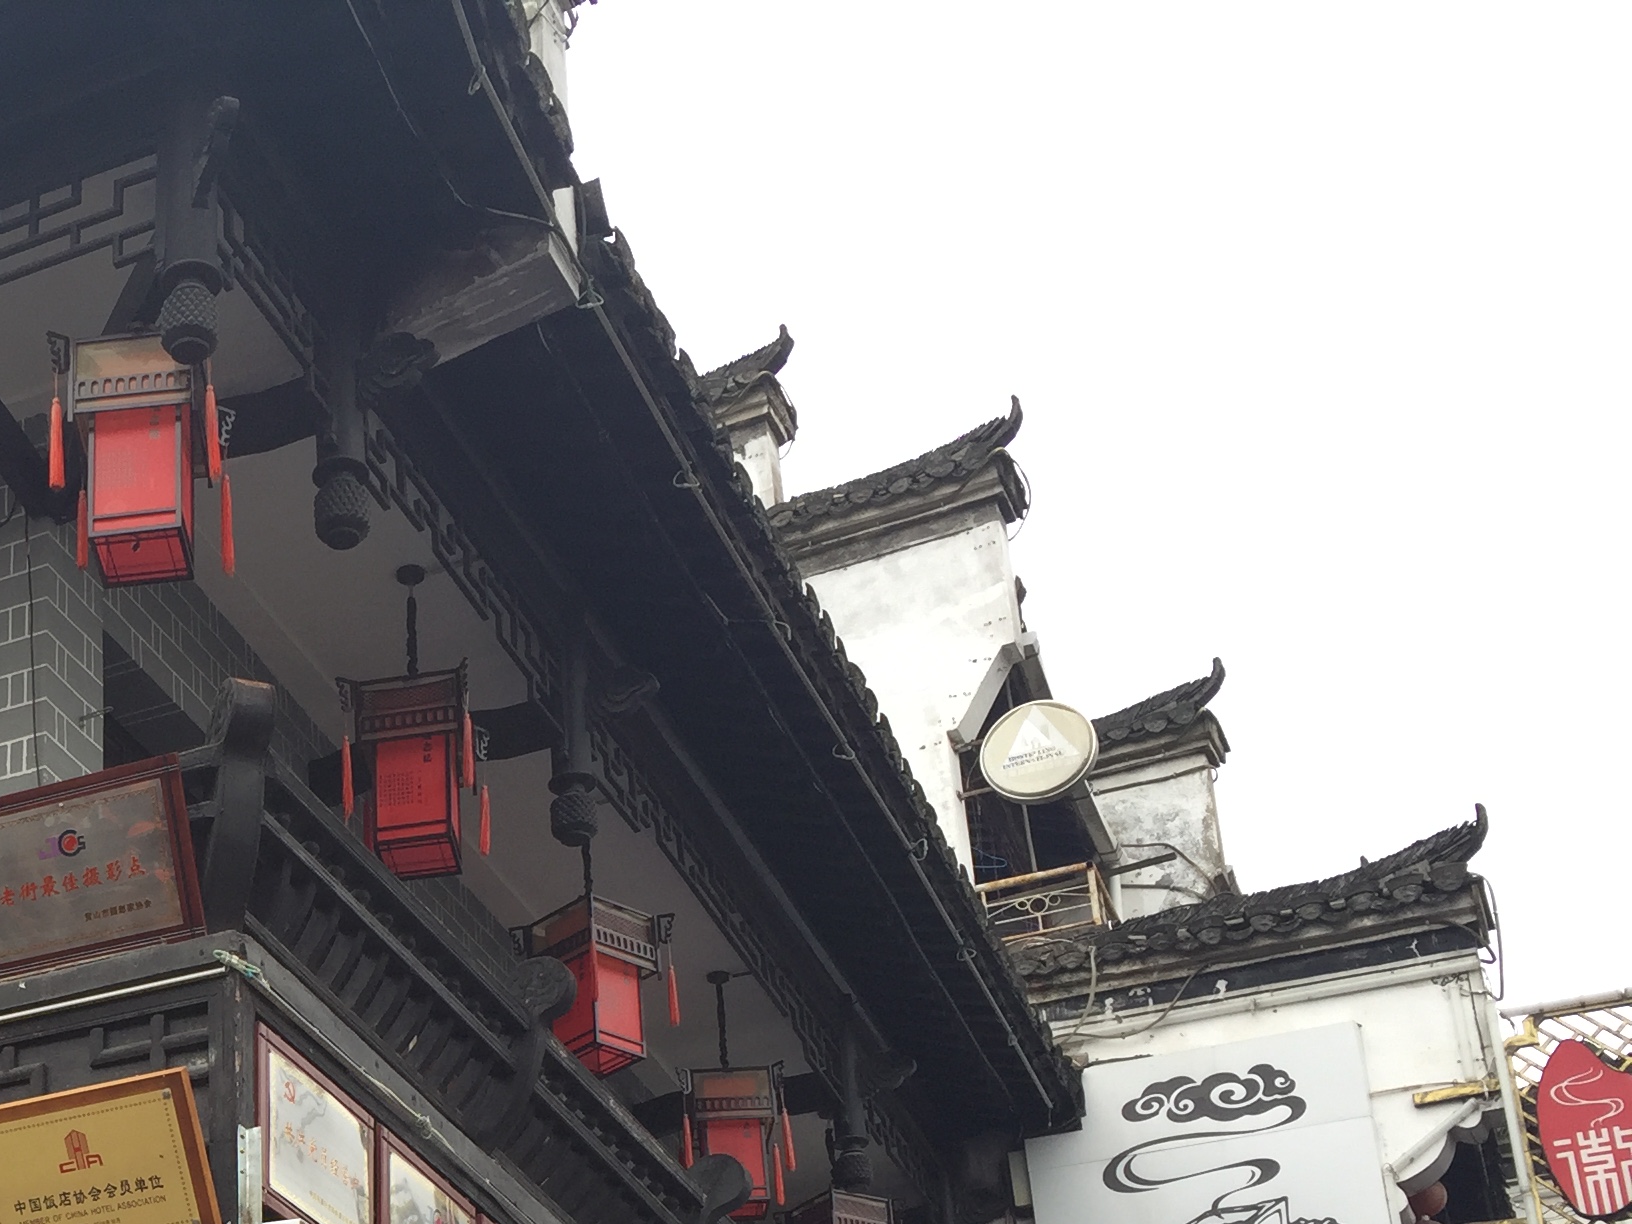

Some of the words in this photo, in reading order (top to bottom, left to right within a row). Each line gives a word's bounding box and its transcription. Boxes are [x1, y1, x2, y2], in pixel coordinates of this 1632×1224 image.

[13, 1175, 165, 1216] 中国饭店协会会员单位
[52, 1213, 63, 1223] OF
[65, 1208, 89, 1221] CHINA
[91, 1203, 115, 1216] HOTEL
[117, 1194, 167, 1211] ASSOCIATION
